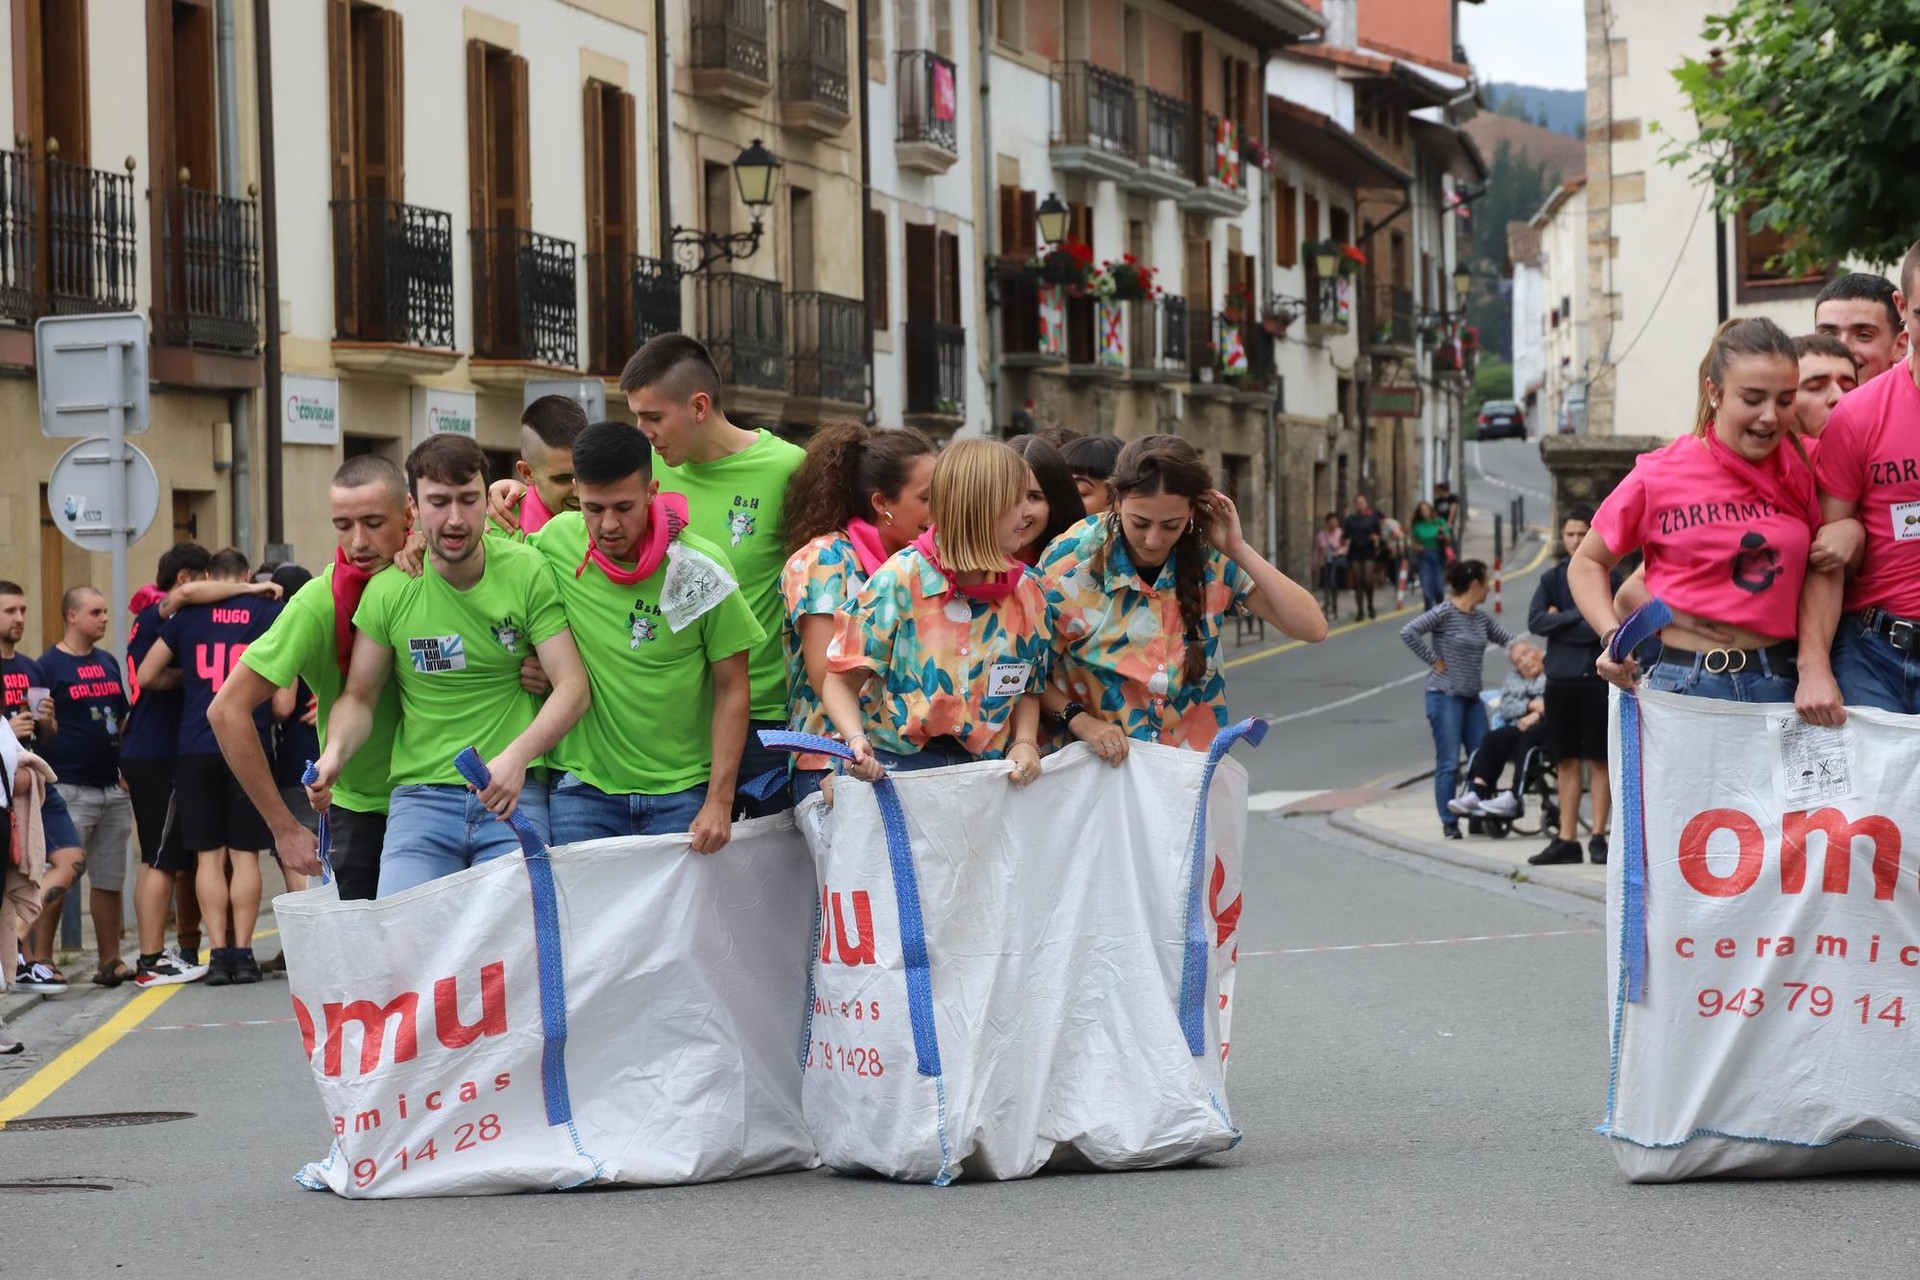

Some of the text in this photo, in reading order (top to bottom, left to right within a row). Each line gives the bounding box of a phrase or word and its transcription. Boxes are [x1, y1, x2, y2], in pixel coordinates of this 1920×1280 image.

[299, 404, 335, 423] COVIRAN
[1870, 459, 1919, 485] ZAR
[733, 495, 742, 507] B
[750, 498, 759, 509] H
[1658, 500, 1781, 535] ZARRAM
[212, 608, 250, 625] HUGO
[634, 599, 643, 611] B
[652, 604, 661, 616] H
[410, 639, 439, 650] GUREKIN
[426, 659, 452, 671] DITUGU
[1678, 807, 1920, 901] om
[1698, 983, 1906, 1028] 943 79 14
[395, 1138, 438, 1171] 14
[454, 1114, 502, 1152] 28
